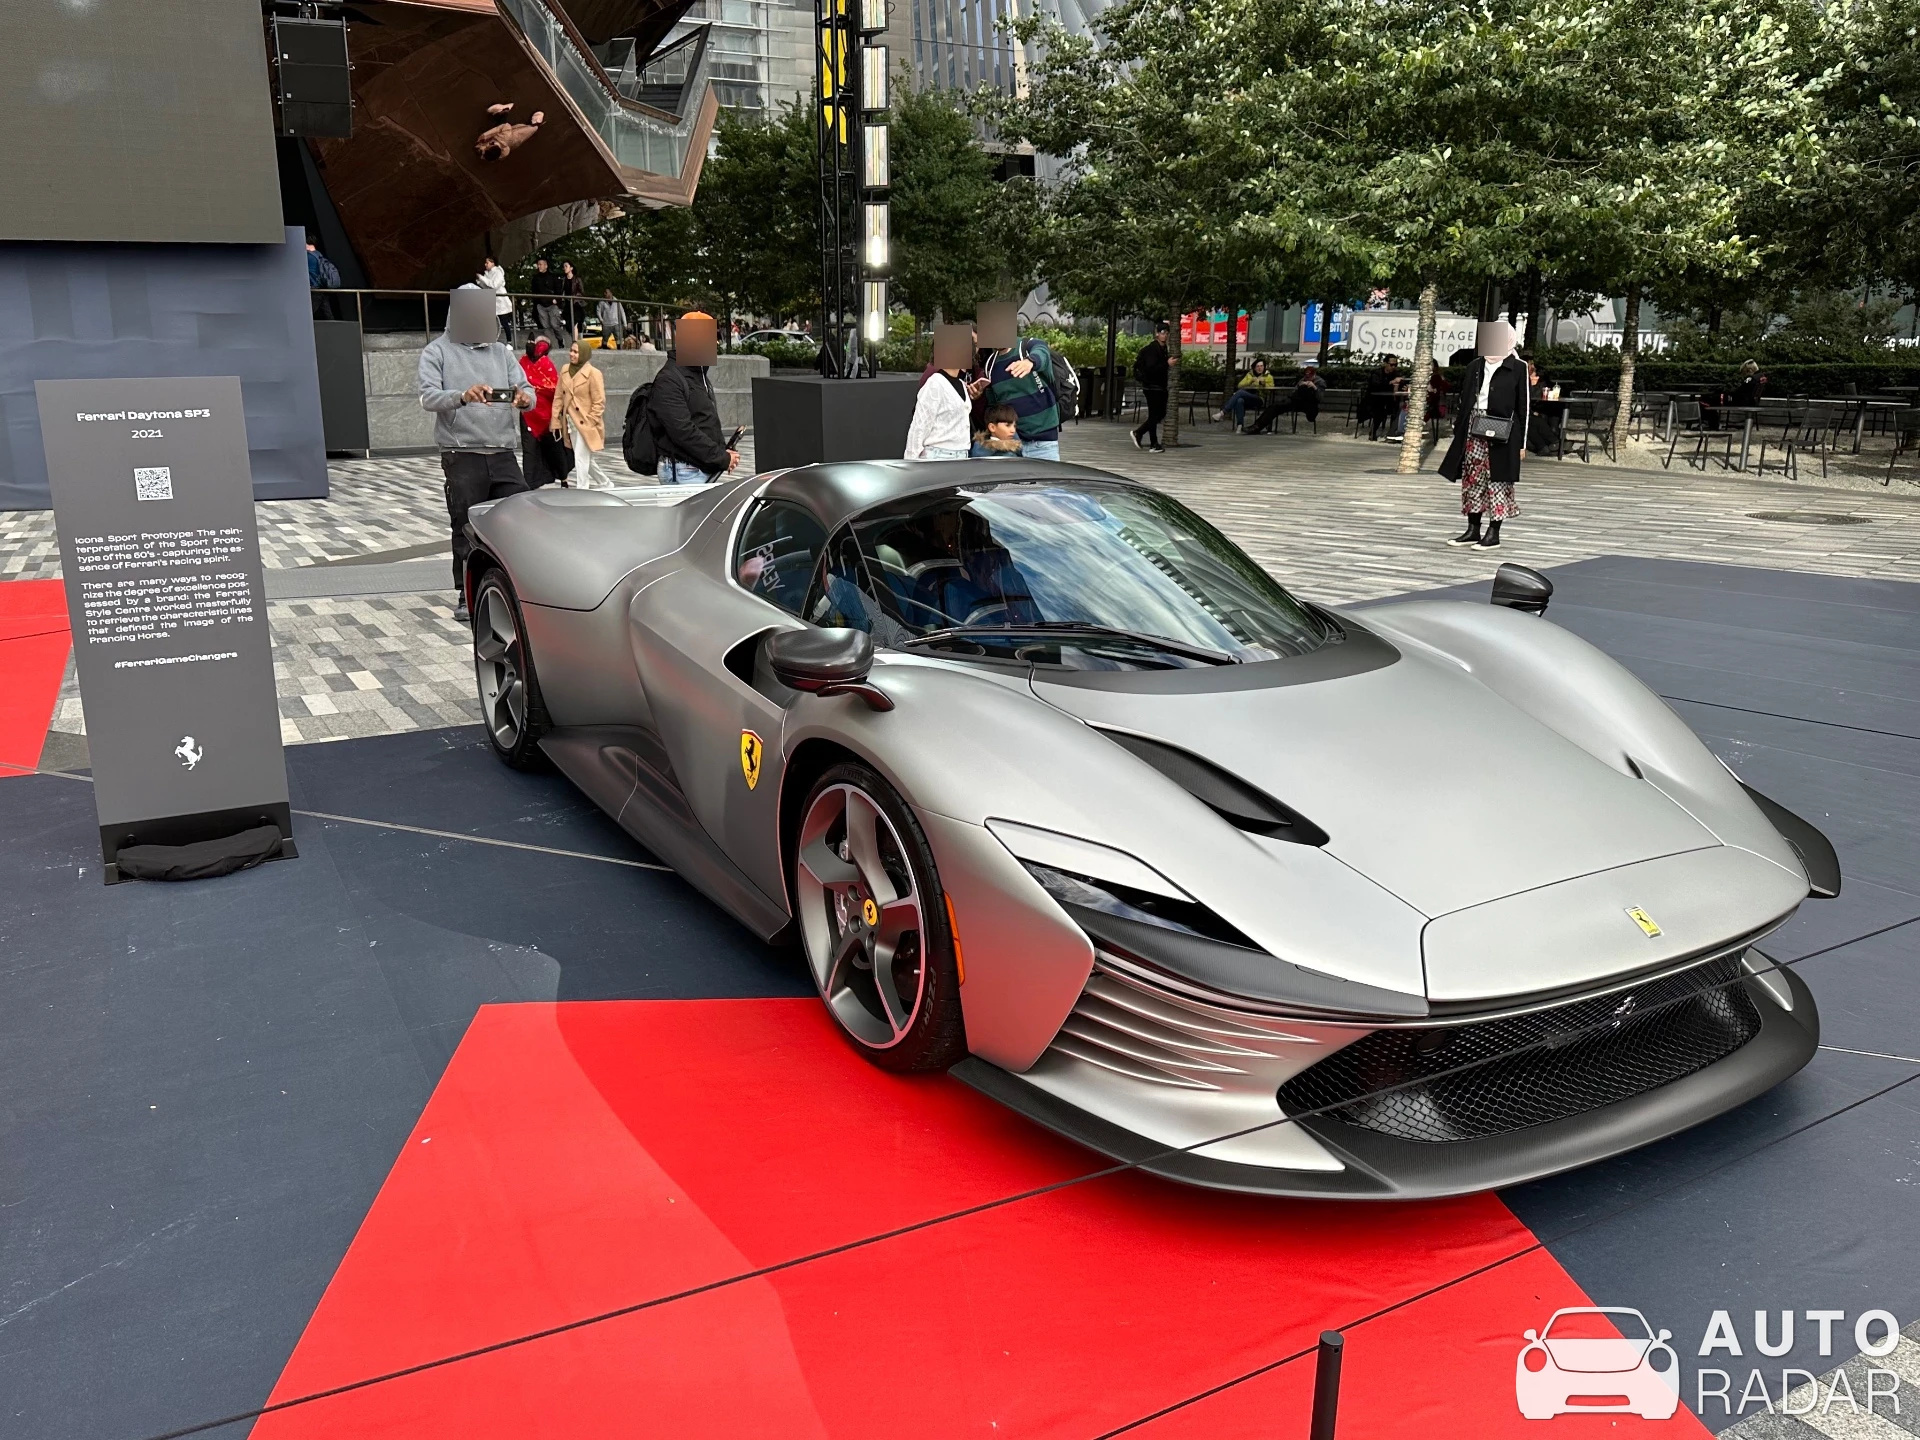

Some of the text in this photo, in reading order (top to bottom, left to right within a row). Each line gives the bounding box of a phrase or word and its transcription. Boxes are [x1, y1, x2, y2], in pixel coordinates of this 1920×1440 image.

[1381, 328, 1474, 341] CENTSTAGE
[77, 409, 210, 421] Ferrari Daytona SP3
[131, 429, 163, 438] 2021
[108, 534, 137, 544] Sport
[141, 530, 193, 540] Prototype:
[197, 529, 215, 537] The
[76, 536, 243, 554] terpretation of the Sport Proto-
[78, 555, 101, 563] type
[162, 547, 210, 558] capturing
[125, 559, 168, 568] Ferrari's
[170, 557, 201, 565] racing
[203, 555, 230, 565] spirit.
[170, 575, 197, 584] ways
[215, 572, 248, 580] recog-
[124, 588, 160, 597] degree
[174, 583, 225, 592] excellence
[228, 582, 249, 590] pos-
[84, 598, 120, 608] sessed
[126, 597, 139, 606] by
[156, 593, 189, 602] brand:
[216, 588, 250, 597] Ferrari
[86, 597, 251, 618] Style Centre worked masterfully
[99, 616, 140, 624] retrieve
[160, 608, 228, 620] characteristic
[88, 626, 109, 634] that
[116, 622, 154, 632] defined
[184, 618, 214, 627] image
[237, 614, 253, 622] the
[90, 631, 170, 644] Prancing Horse.
[115, 652, 238, 668] #FerrariGameChangers
